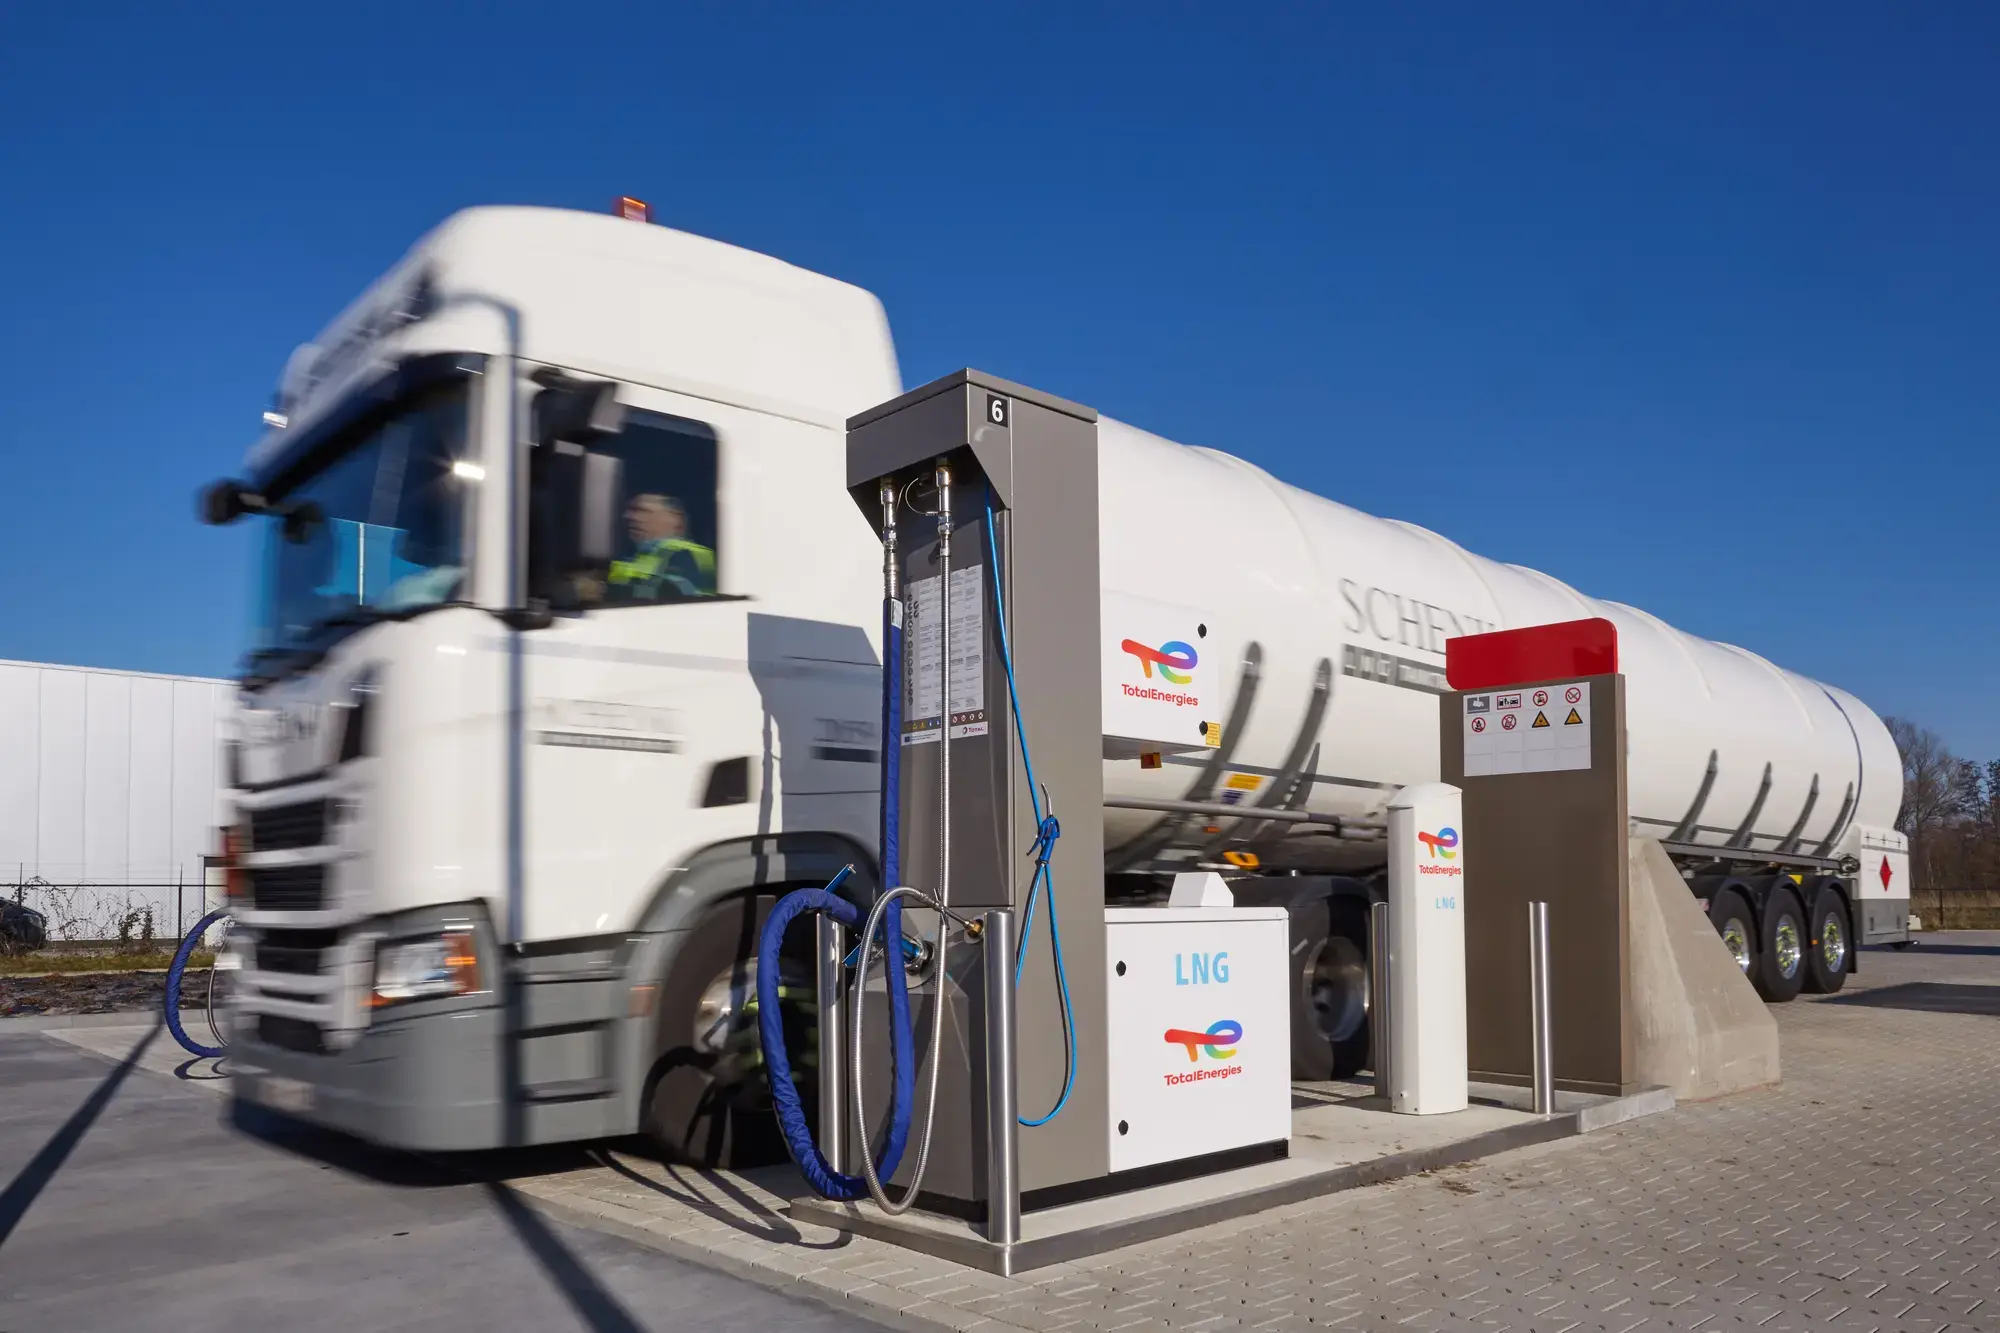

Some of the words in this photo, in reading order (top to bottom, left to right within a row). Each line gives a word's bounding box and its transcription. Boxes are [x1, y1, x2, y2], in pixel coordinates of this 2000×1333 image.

[991, 399, 1004, 423] 6
[1121, 683, 1199, 707] TotalEnergies
[1418, 864, 1462, 877] TotalEnergies
[1435, 897, 1456, 910] LNG
[1175, 951, 1229, 986] LNG
[1163, 1065, 1242, 1086] TotalEnergies
